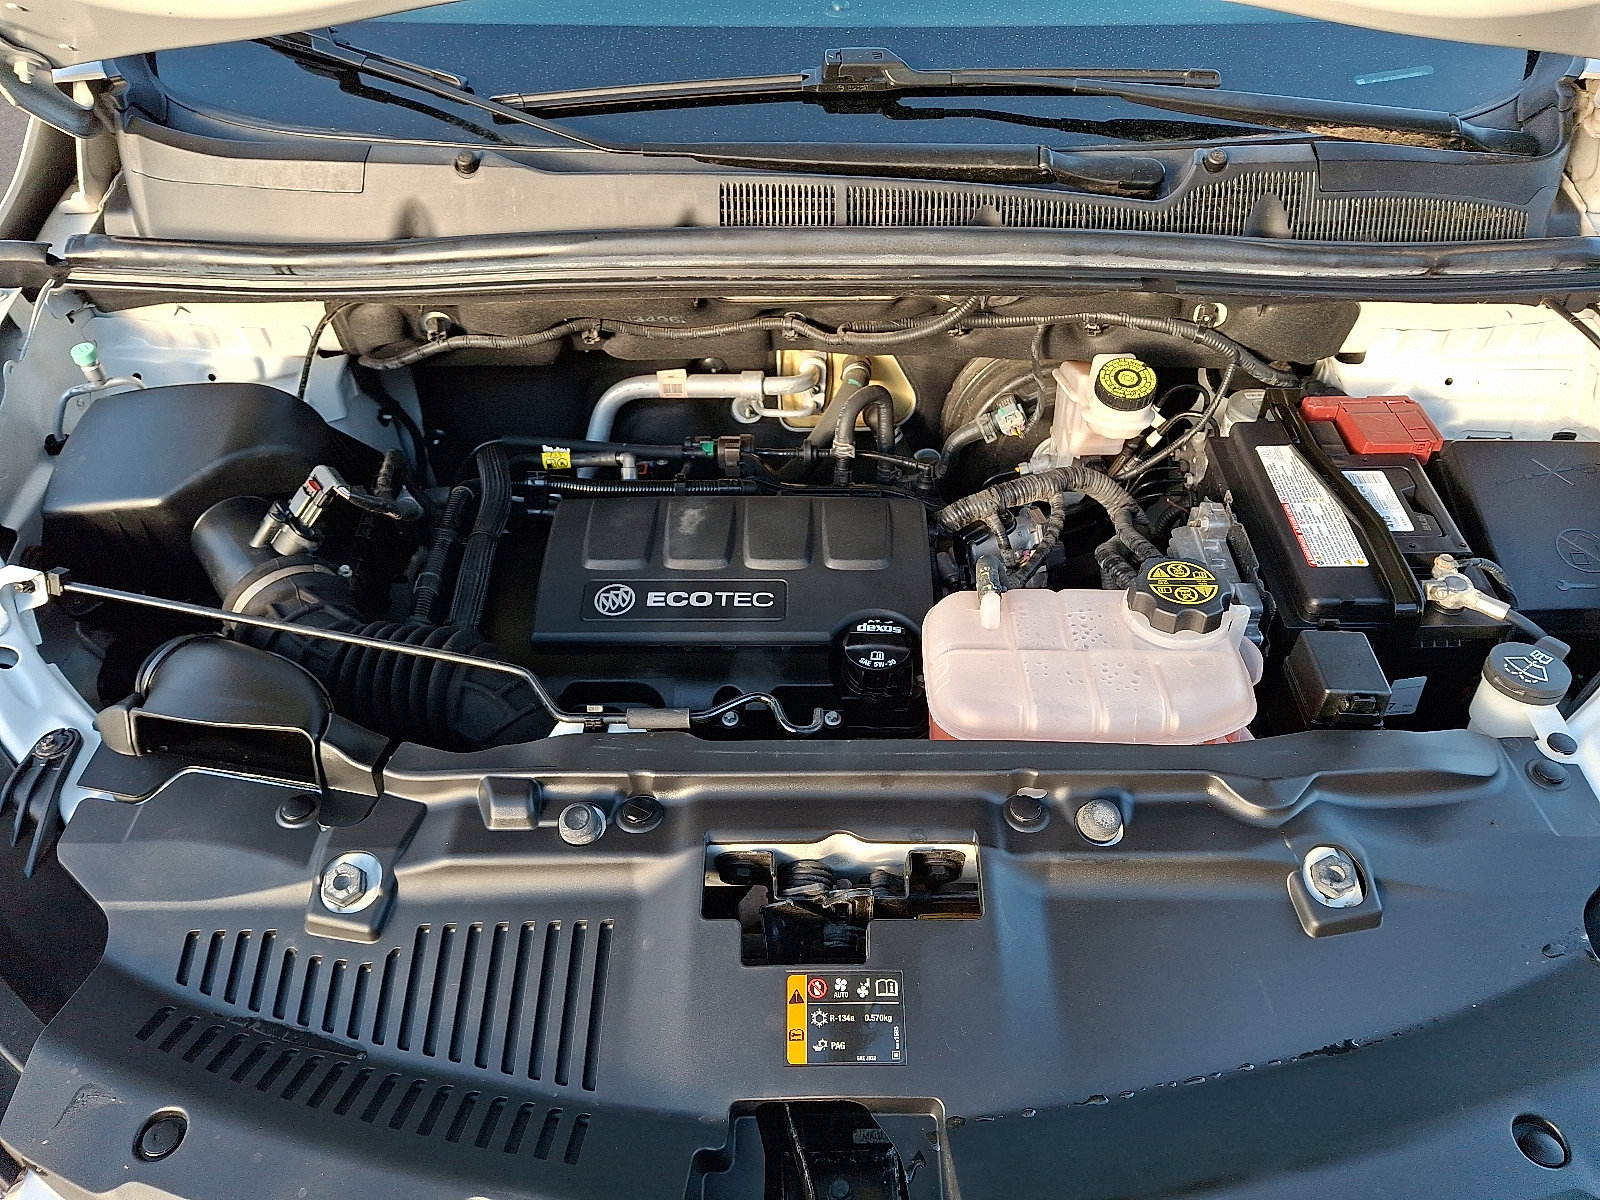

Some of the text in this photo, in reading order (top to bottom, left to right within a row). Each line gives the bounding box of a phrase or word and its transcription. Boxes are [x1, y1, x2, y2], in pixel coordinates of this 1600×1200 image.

[646, 591, 775, 607] ECOTEC
[856, 622, 902, 634] dexos
[858, 657, 897, 668] SAE 5W-30
[833, 991, 849, 999] AUTO
[829, 1013, 893, 1023] R-134a 0.570kg
[830, 1041, 846, 1050] PAG
